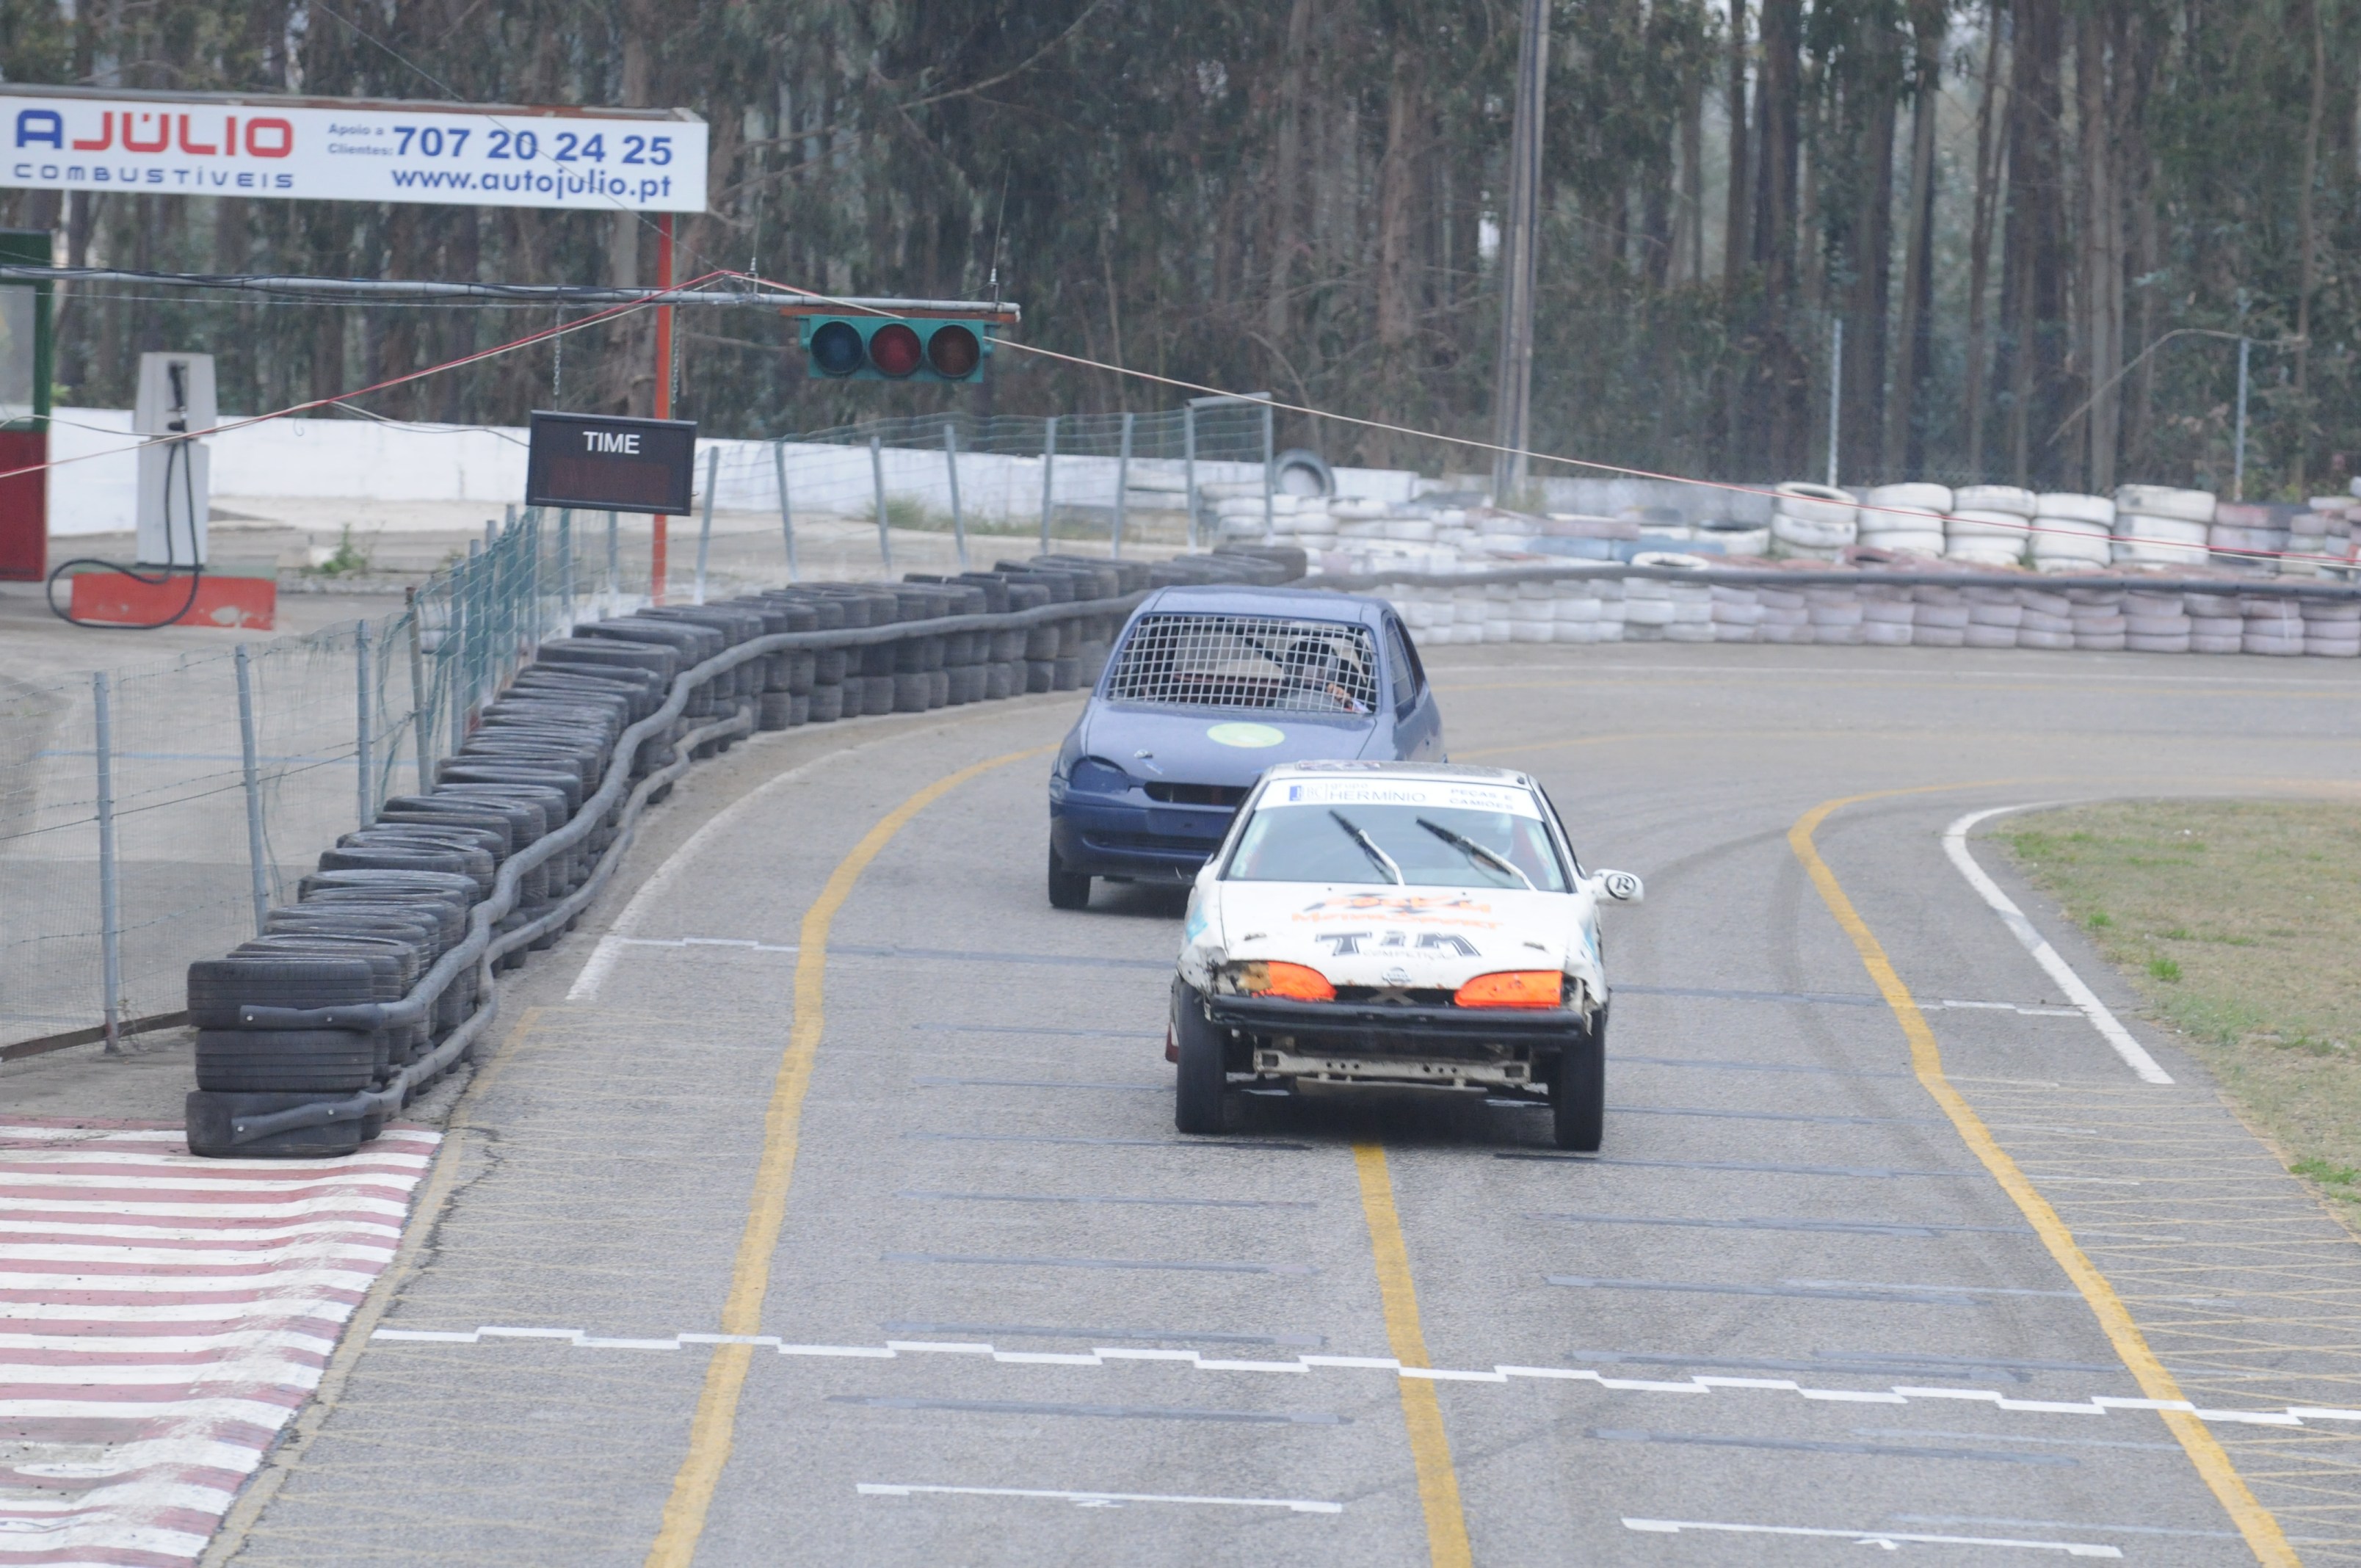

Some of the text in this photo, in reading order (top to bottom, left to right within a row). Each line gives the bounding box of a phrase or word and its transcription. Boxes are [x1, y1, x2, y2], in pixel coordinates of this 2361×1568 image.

[327, 123, 384, 137] Apoio a
[327, 142, 394, 156] Clientes:
[393, 125, 672, 166] 707 20 24 25
[14, 162, 294, 189] COMBUSTÍVEIS
[391, 169, 672, 203] www.autojulio.pt
[582, 430, 641, 454] TIME
